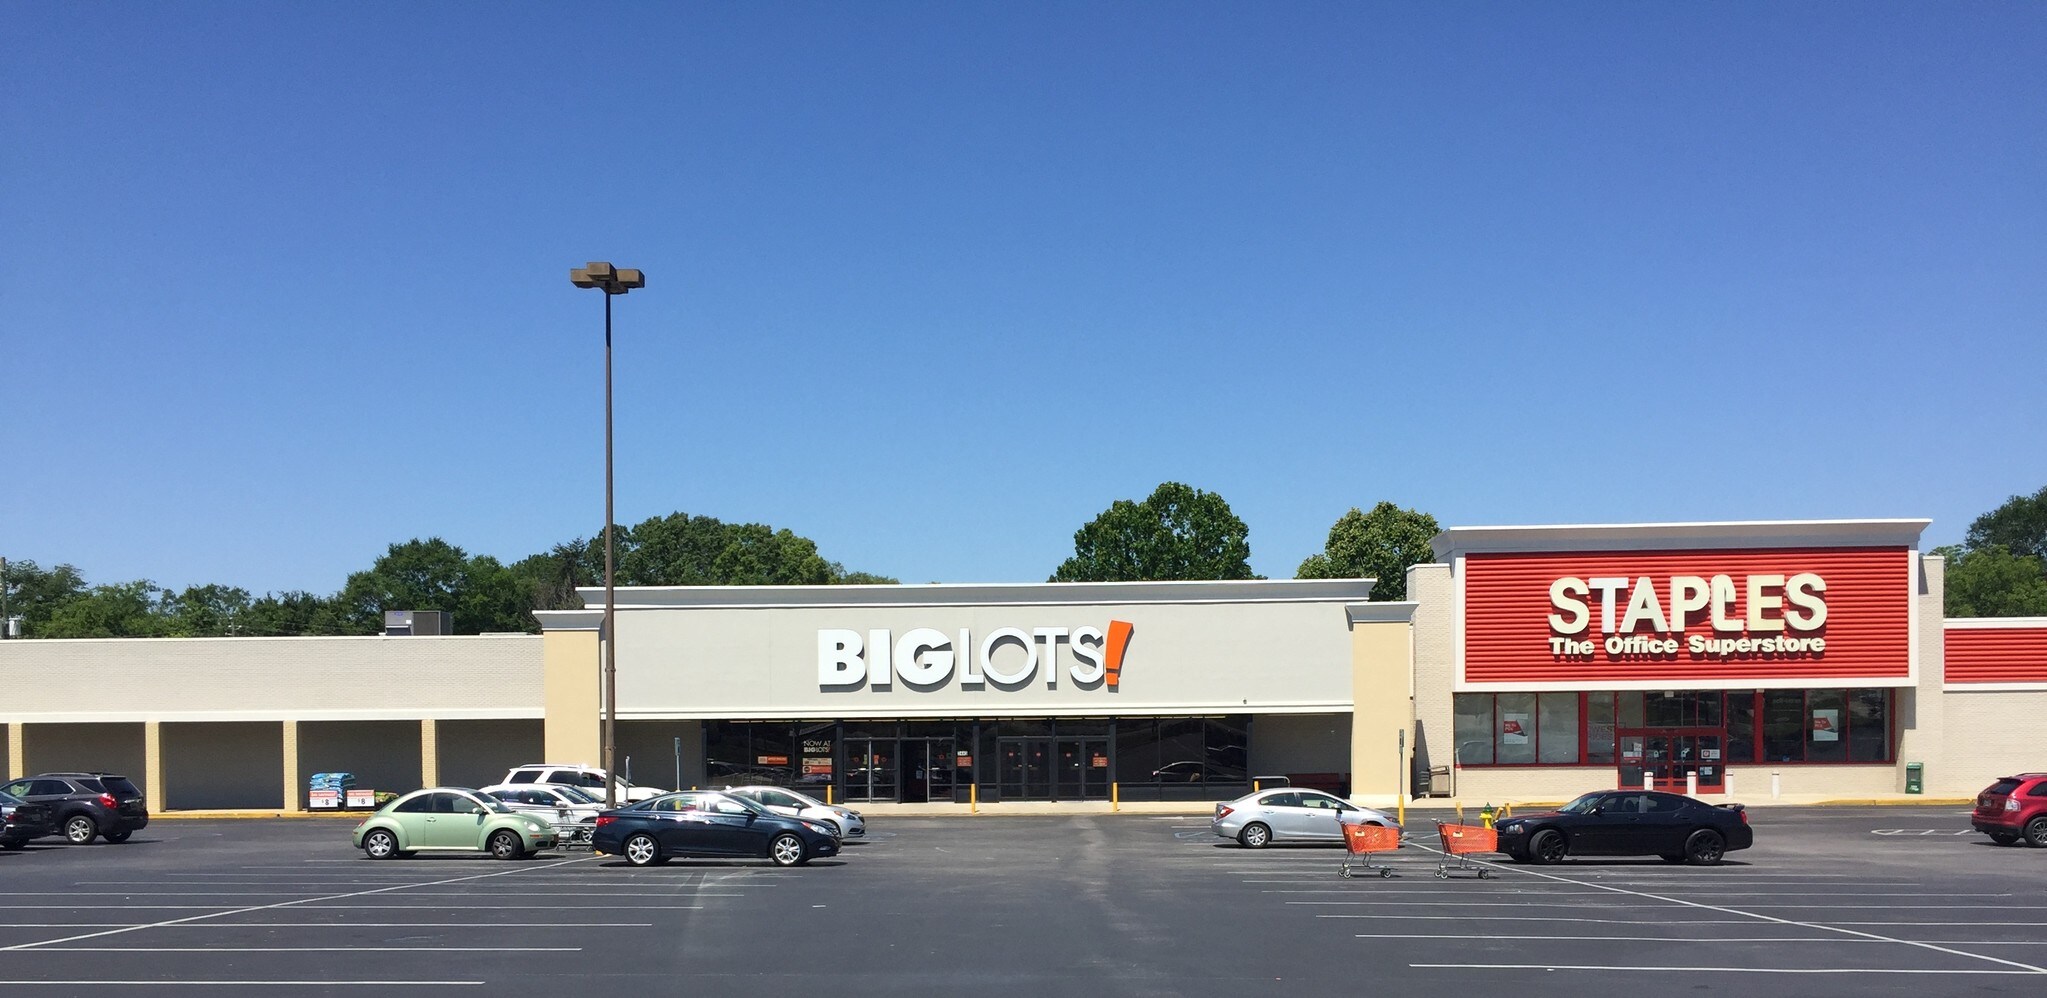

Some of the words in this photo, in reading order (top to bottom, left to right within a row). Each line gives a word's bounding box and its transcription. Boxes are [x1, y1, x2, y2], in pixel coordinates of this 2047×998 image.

[1548, 573, 1828, 634] STAPLES
[1548, 637, 1595, 655] The
[1604, 635, 1679, 655] Office
[1688, 634, 1826, 656] Superstore
